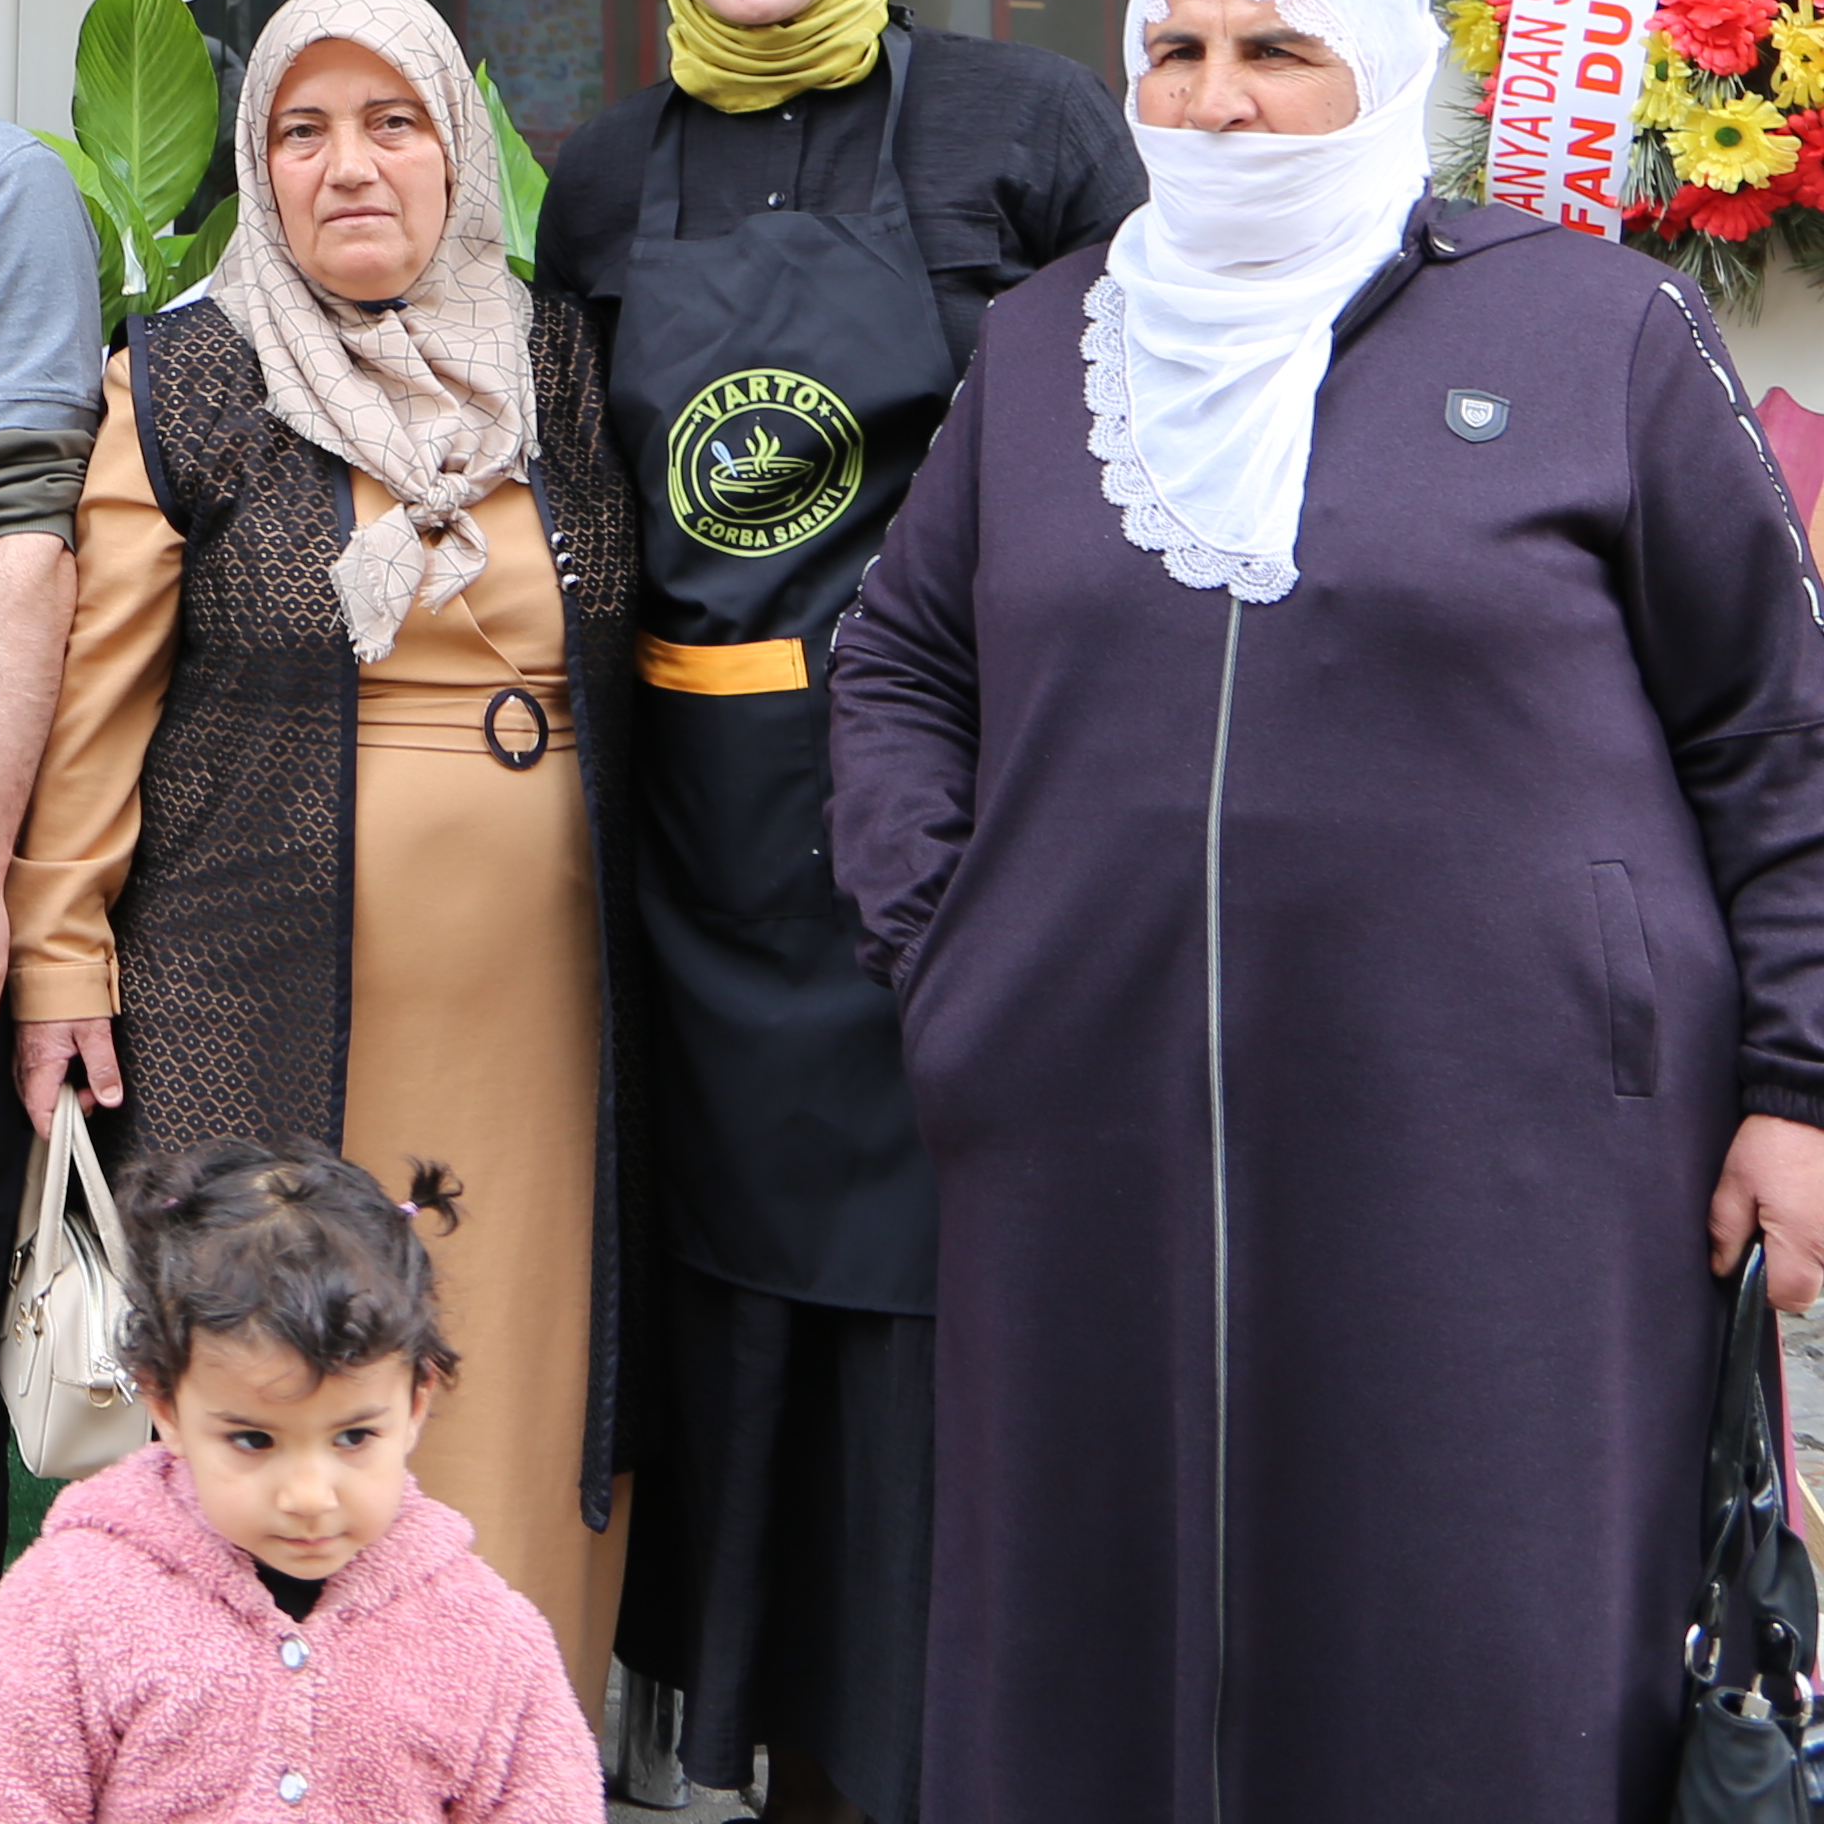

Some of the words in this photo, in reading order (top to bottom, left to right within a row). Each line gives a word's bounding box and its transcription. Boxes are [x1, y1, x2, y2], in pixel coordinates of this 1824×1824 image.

[696, 375, 820, 421] VARTO
[696, 515, 770, 548] ÇORBA
[772, 487, 843, 545] SARAYI
